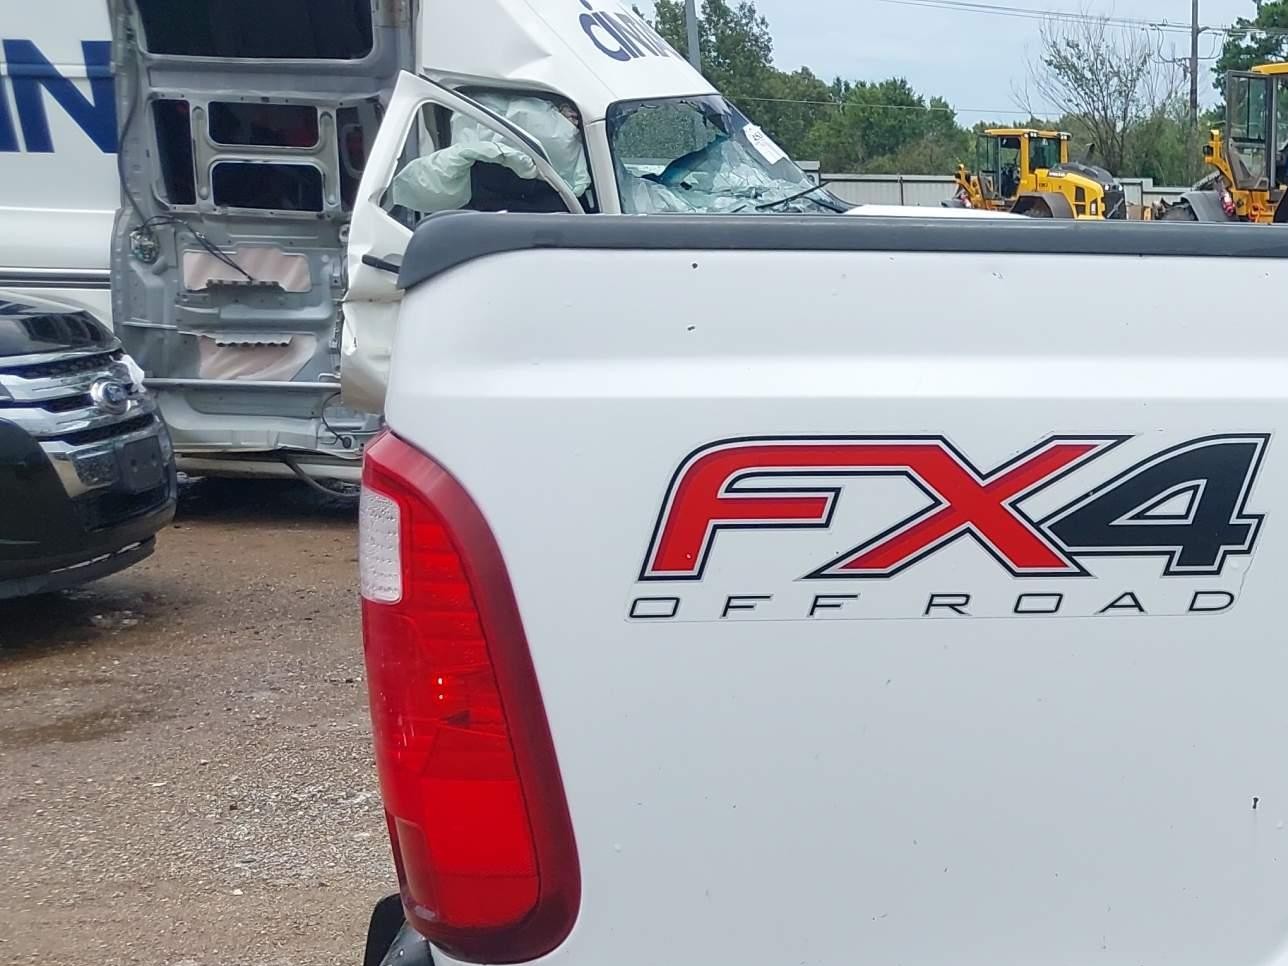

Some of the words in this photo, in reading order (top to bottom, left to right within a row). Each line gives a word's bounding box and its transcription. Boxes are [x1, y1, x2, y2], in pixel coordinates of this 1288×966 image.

[637, 432, 1272, 580] FX4
[627, 593, 860, 619] OFF
[924, 589, 1235, 615] ROAD
